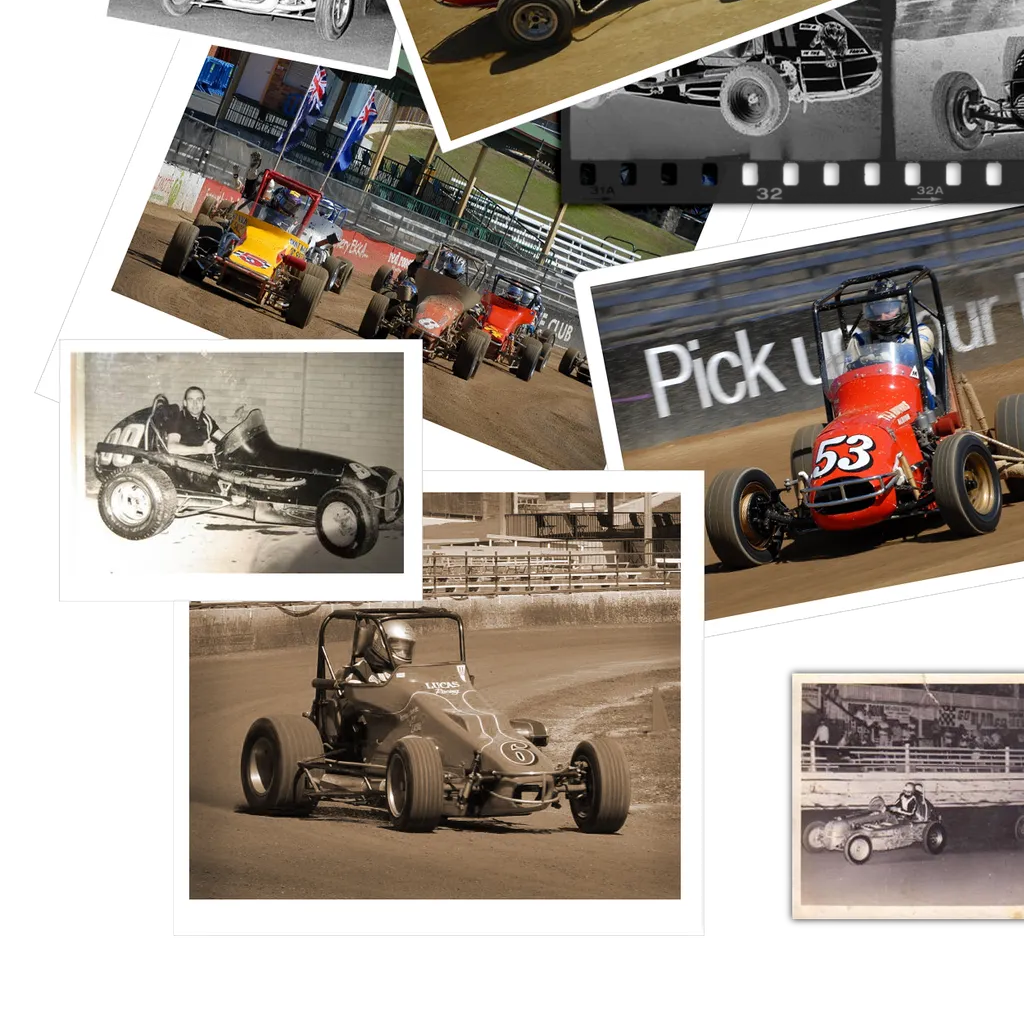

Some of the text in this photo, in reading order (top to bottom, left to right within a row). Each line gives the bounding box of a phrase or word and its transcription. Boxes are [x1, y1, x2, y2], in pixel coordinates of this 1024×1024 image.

[547, 318, 574, 342] CLUB
[644, 328, 788, 419] Pick
[812, 433, 876, 479] 53
[425, 681, 460, 689] LUCAS
